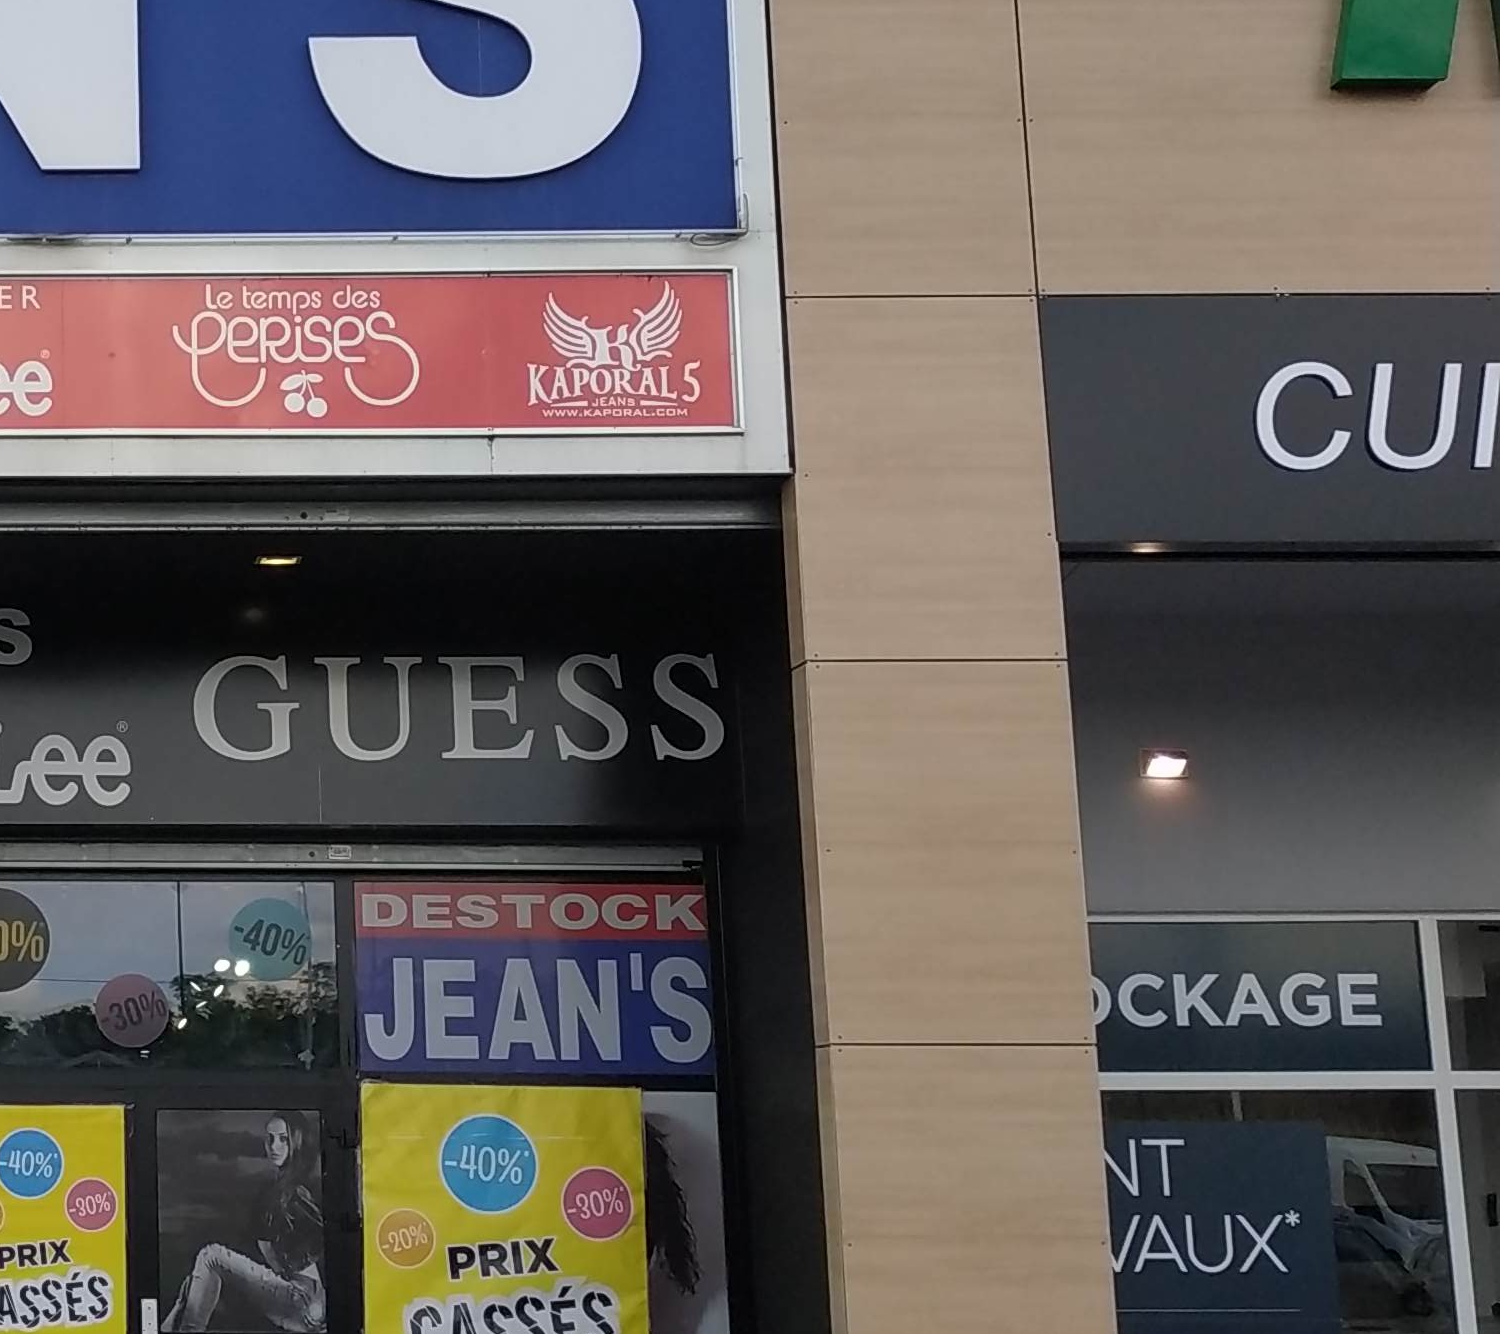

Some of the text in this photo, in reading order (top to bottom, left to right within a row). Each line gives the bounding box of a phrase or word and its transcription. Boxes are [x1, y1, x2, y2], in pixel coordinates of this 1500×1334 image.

[242, 286, 321, 315] temps
[332, 285, 381, 309] des
[527, 360, 700, 406] KAPORAL 5
[592, 397, 636, 407] JEANS
[542, 408, 688, 417] WWW.KAPORAL.COM
[193, 653, 725, 762] GUESS
[362, 892, 705, 931] DESTOCK
[234, 921, 307, 965] -40%
[101, 992, 167, 1032] -30%
[365, 951, 712, 1064] JEAN'S
[446, 1239, 559, 1281] PRIX
